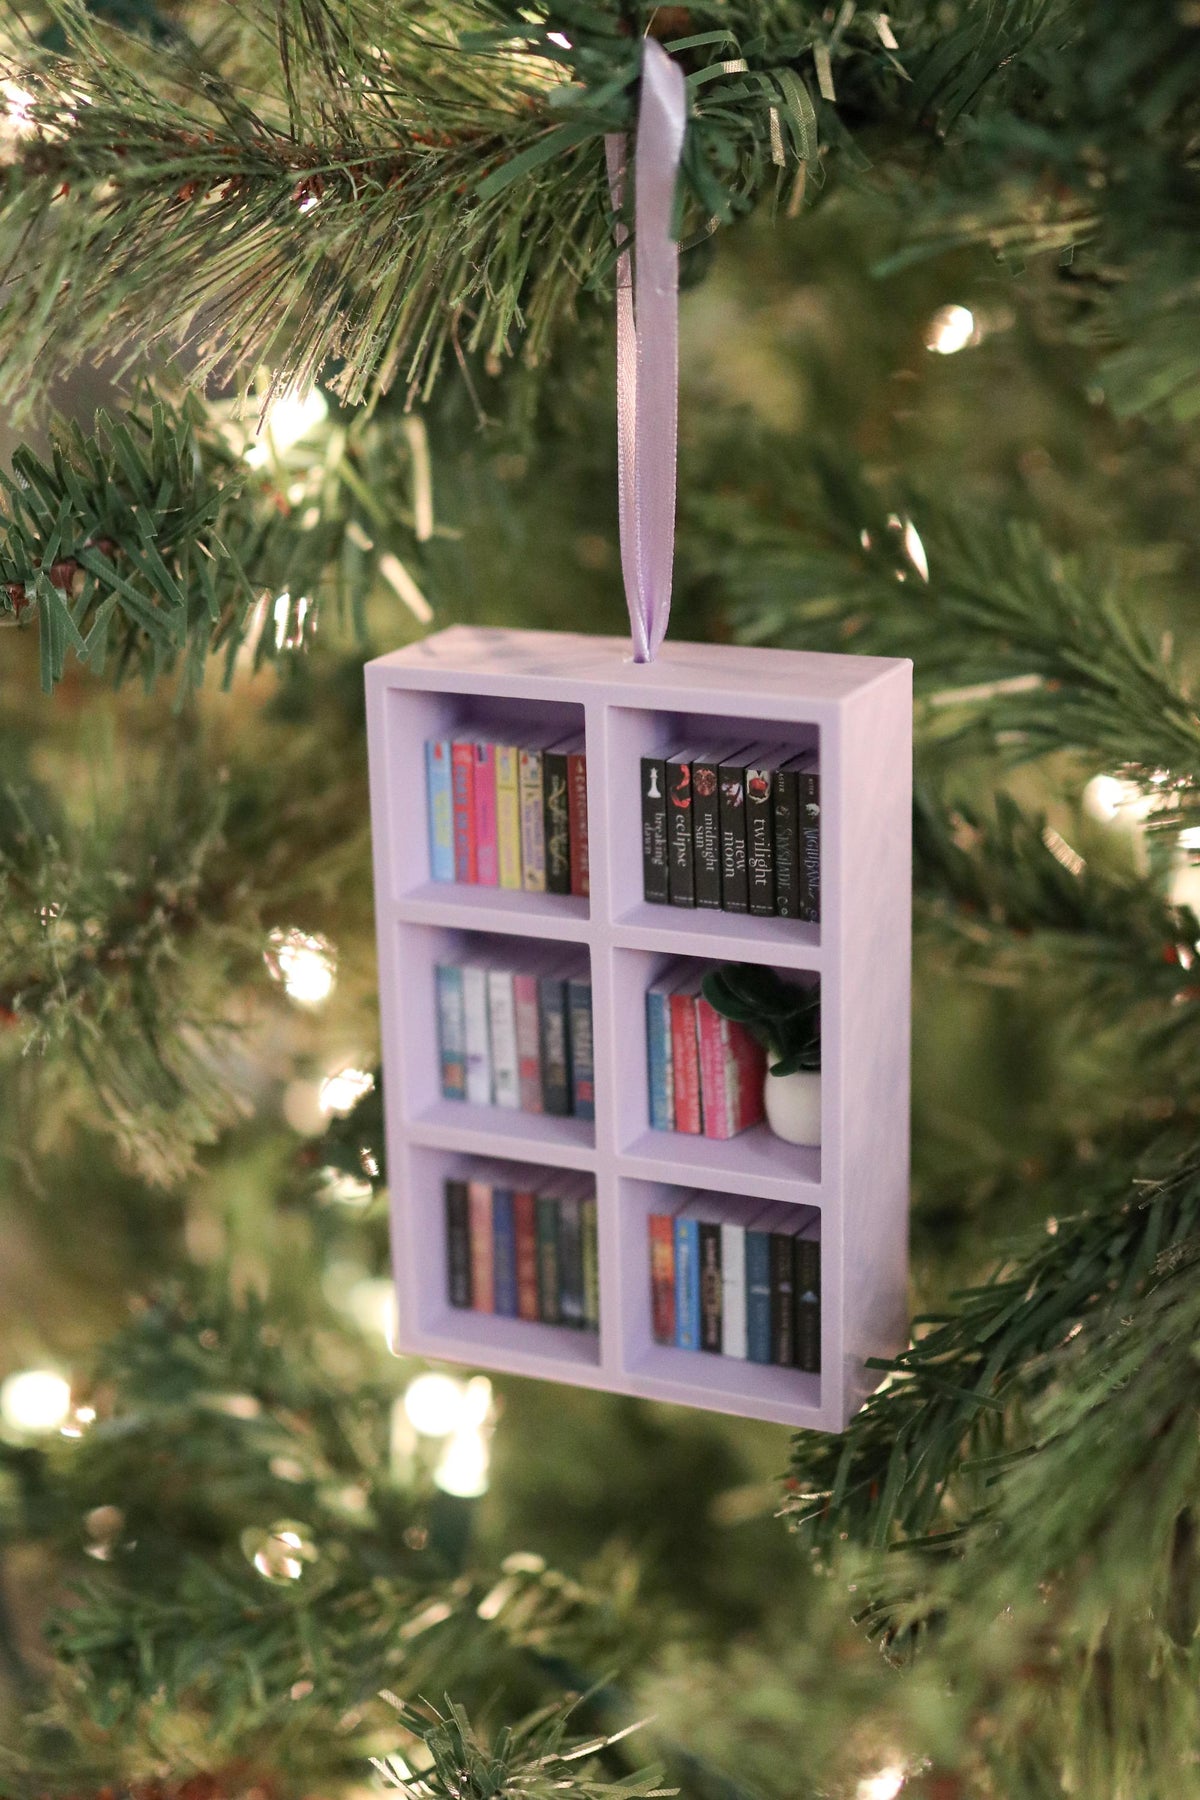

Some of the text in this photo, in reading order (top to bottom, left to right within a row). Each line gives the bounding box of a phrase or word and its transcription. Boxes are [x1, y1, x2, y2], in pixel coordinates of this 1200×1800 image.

[644, 822, 653, 855] dawn
[651, 812, 666, 866] breaking
[672, 814, 691, 867] eclipse
[695, 825, 704, 848] sun
[700, 813, 716, 872] midnight
[723, 831, 735, 878] moon
[734, 838, 746, 872] new
[749, 818, 773, 886] twilight
